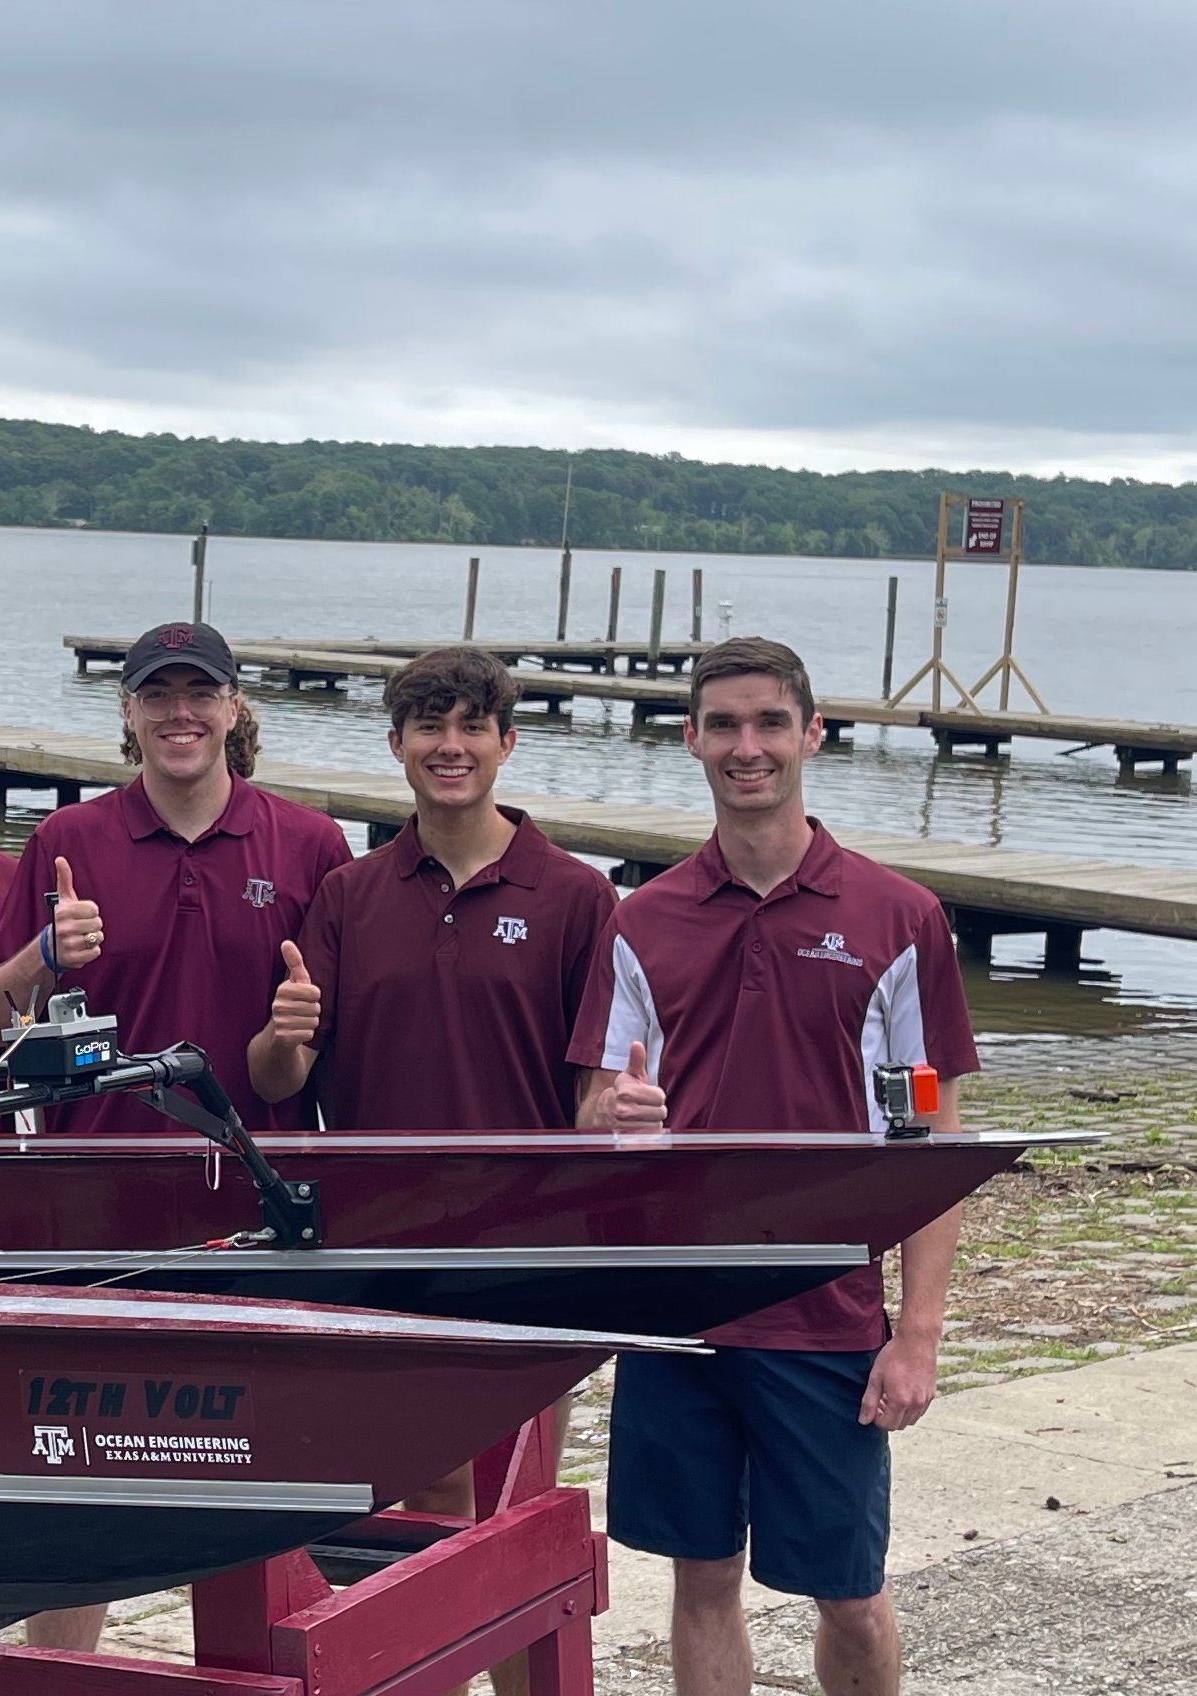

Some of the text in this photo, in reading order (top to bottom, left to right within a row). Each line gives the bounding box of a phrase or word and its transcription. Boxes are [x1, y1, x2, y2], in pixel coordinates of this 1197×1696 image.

[75, 1041, 110, 1056] GoPro
[28, 1376, 246, 1420] 12TH VOLT
[95, 1434, 250, 1451] OCEAN ENGINEERING
[141, 1451, 172, 1462] A&M
[172, 1452, 252, 1464] UNIVERSITY
